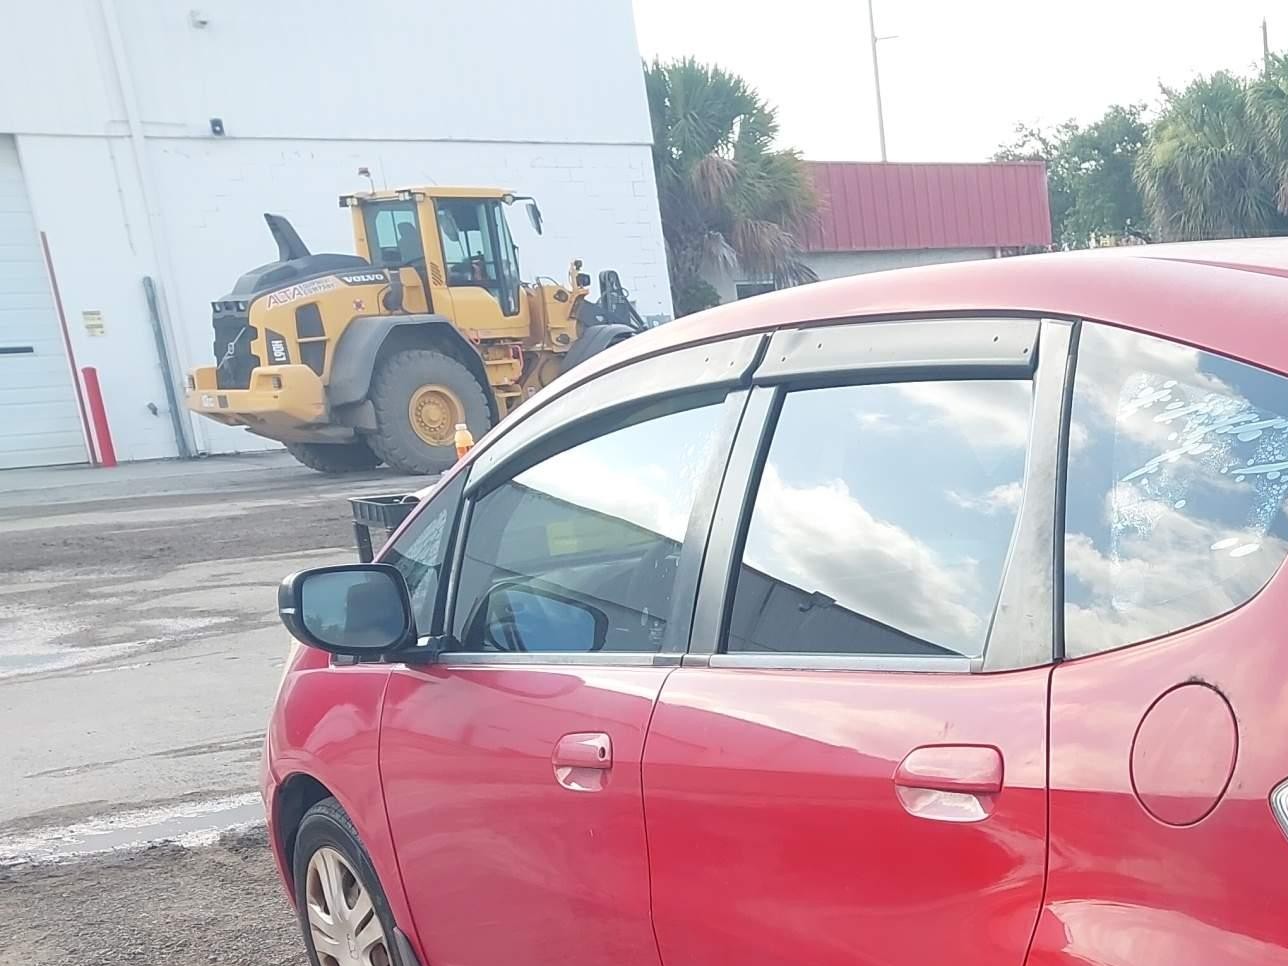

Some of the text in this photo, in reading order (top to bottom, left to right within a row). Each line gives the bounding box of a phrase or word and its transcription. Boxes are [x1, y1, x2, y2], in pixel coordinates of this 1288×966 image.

[342, 274, 384, 283] VOLVO
[267, 286, 303, 309] ALTA
[271, 340, 286, 361] L90H
